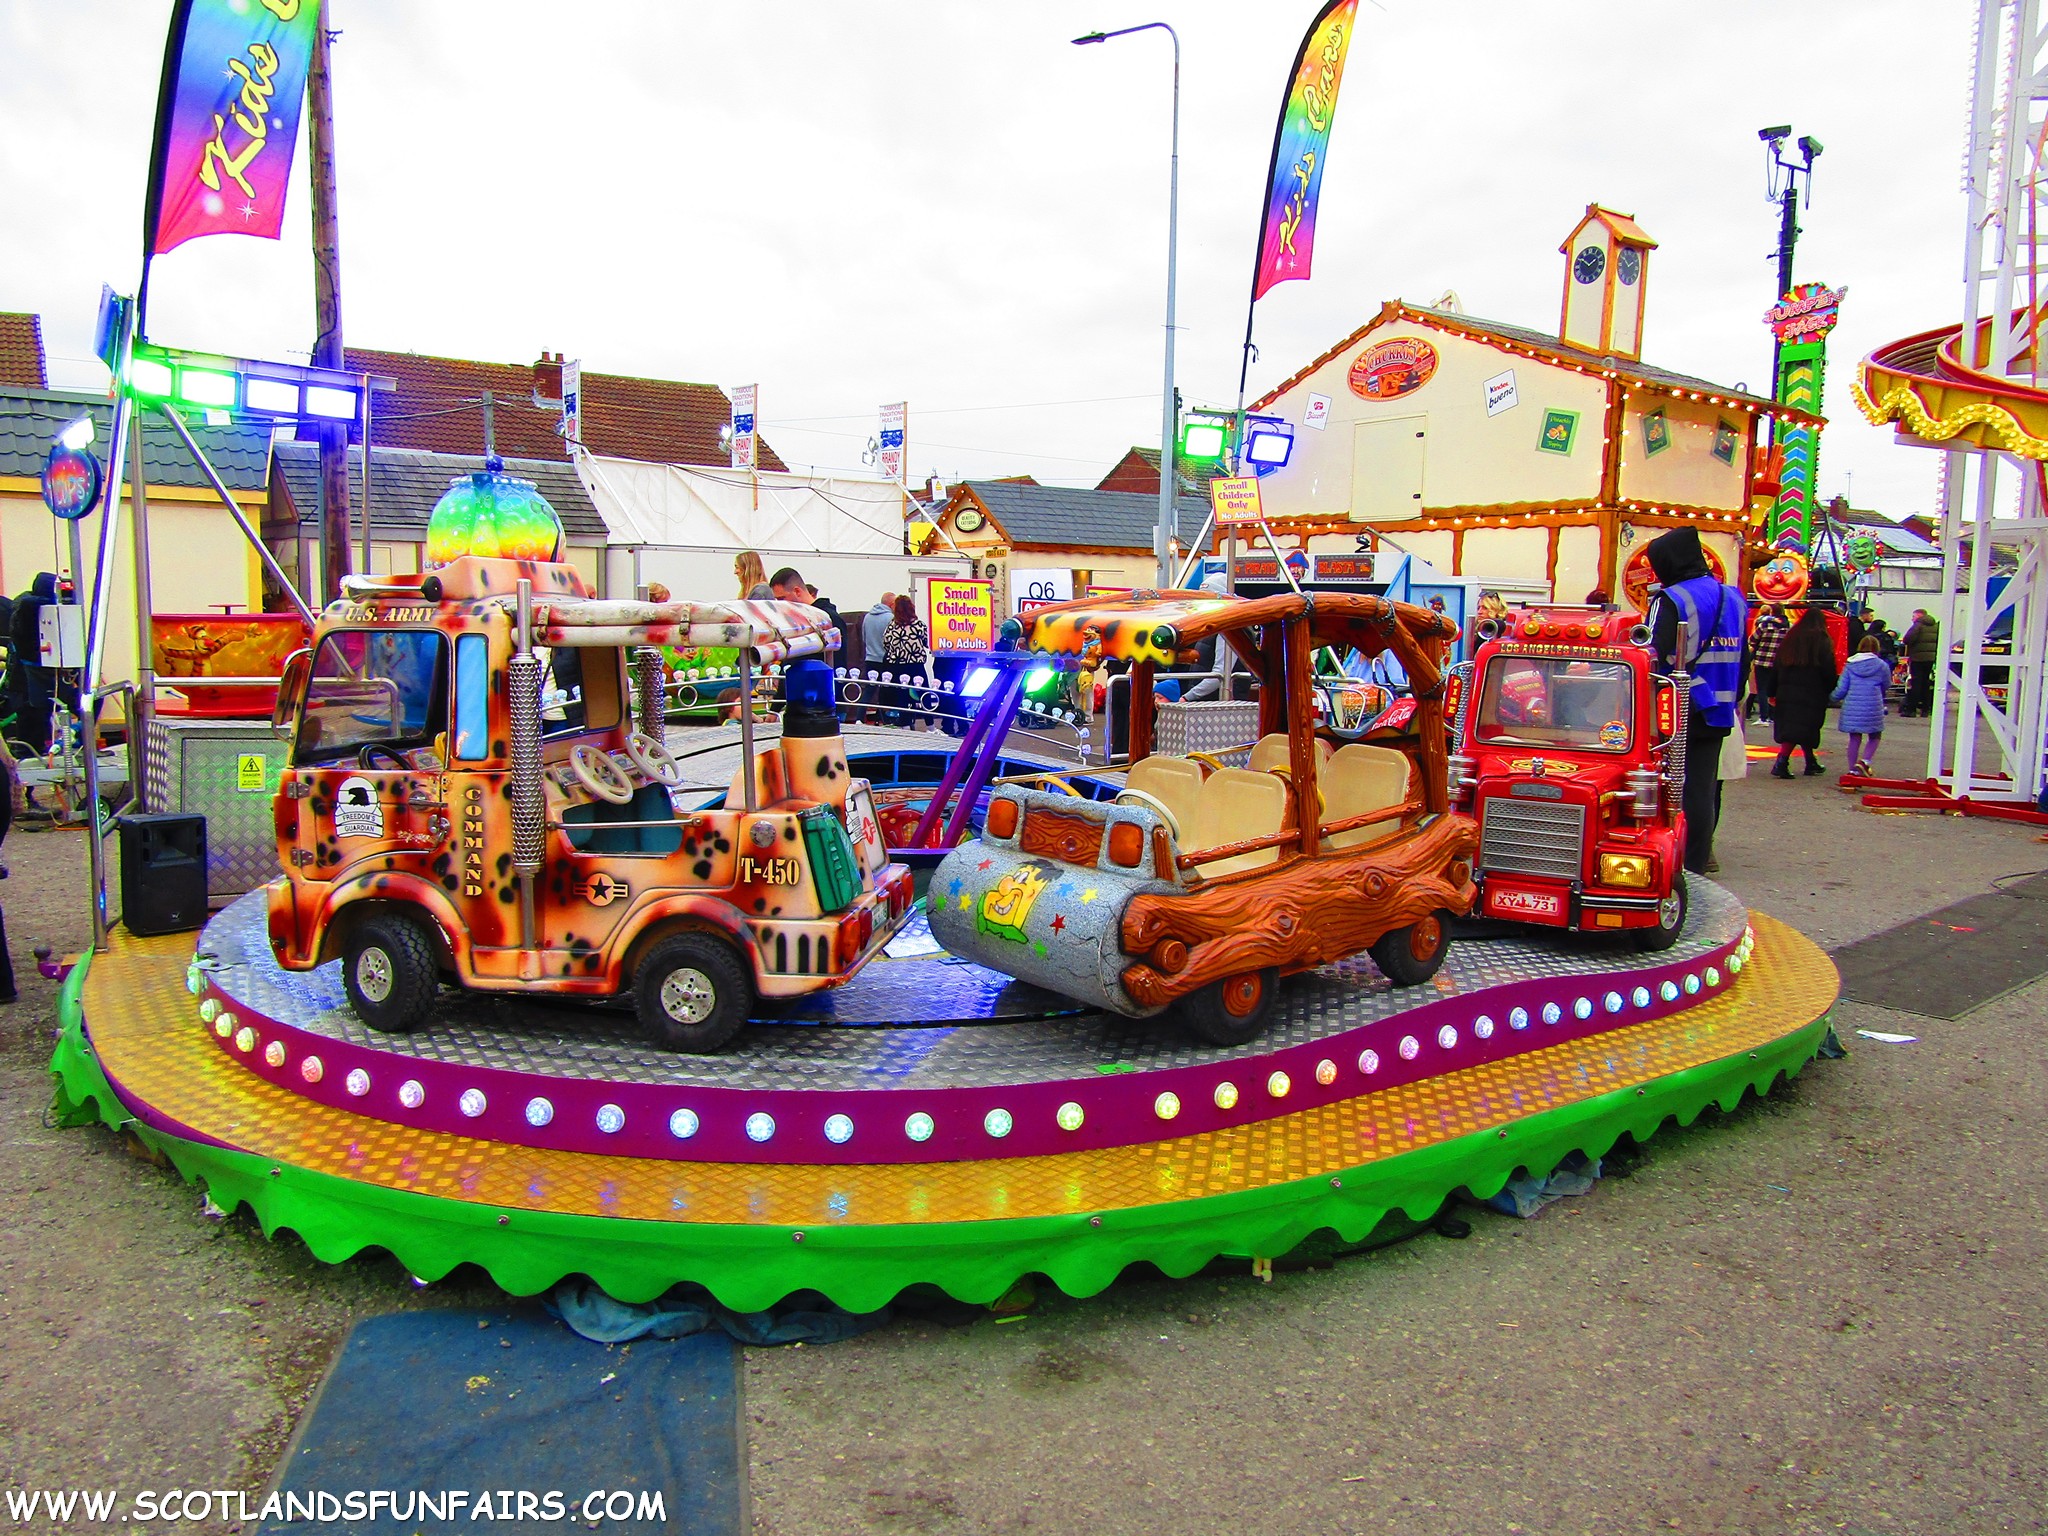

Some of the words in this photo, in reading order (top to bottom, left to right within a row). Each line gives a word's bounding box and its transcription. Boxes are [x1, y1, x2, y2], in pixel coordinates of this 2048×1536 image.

[199, 40, 280, 199] Kids
[1279, 147, 1316, 256] Kids
[1303, 24, 1343, 134] Cars
[1783, 314, 1829, 339] JACK
[1367, 344, 1416, 370] CHURROS
[1489, 381, 1509, 393] Kinder
[1489, 387, 1514, 408] bueno
[882, 451, 900, 464] BRANDY
[1222, 481, 1248, 490] Small
[1218, 491, 1255, 500] Children
[1227, 501, 1248, 509] Only
[1235, 511, 1258, 519] Adults
[1245, 562, 1278, 574] PIRATE
[1318, 562, 1356, 574] BLASTA
[944, 586, 978, 600] Small
[1029, 581, 1055, 600] Q6
[345, 607, 378, 621] U.S.
[383, 607, 437, 622] ARMY
[936, 602, 987, 617] Children
[948, 618, 977, 635] Only
[938, 637, 953, 649] No
[957, 637, 987, 649] Adults
[1500, 643, 1520, 653] LOS
[1522, 643, 1570, 654] ANGELES
[1572, 645, 1598, 657] FIRE
[1448, 679, 1461, 714] FIRE
[1660, 693, 1670, 730] FIRE
[342, 813, 376, 822] FREEDOM'S
[344, 824, 375, 832] GUARDIAN
[463, 789, 484, 896] COMMAND
[741, 857, 800, 886] T-450
[1533, 899, 1557, 911] 731
